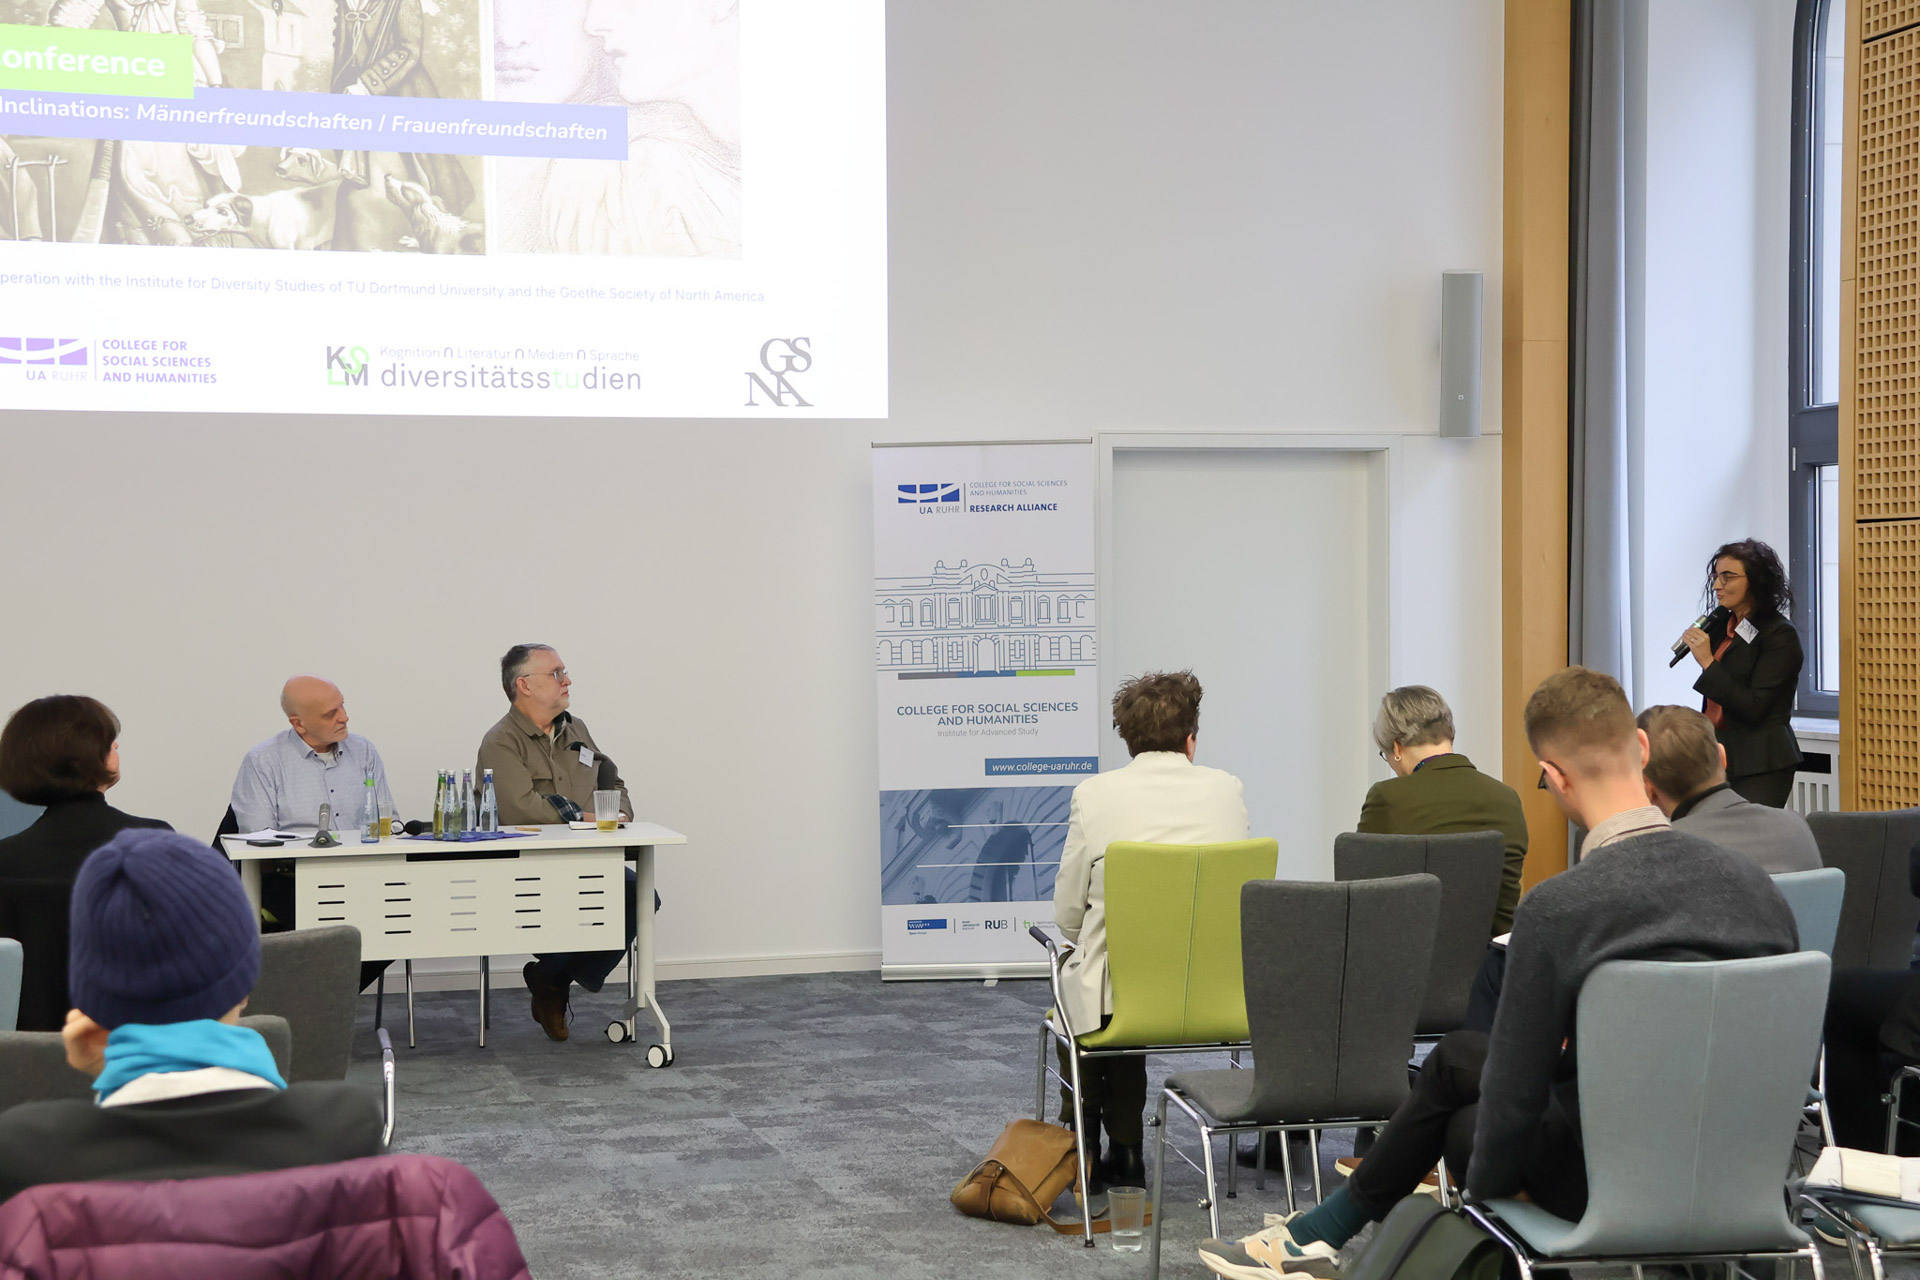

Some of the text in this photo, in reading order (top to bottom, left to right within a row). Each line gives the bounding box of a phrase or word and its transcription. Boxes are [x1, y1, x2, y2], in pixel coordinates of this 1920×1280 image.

[0, 45, 166, 77] onference
[0, 96, 131, 120] Inclinations:
[136, 104, 372, 130] Männerfreundschaften
[392, 116, 608, 140] Frauenfreundschaften
[0, 272, 764, 302] peration with the Institute for Diversity Studies of TU Dortmund University and the Goethe Society of North America
[102, 340, 188, 350] COLLEGE FOR
[380, 346, 640, 362] Kognition Literatur Medien Sprache
[760, 336, 812, 373] GS
[102, 356, 212, 368] SOCIAL SCIENCES
[26, 370, 88, 382] UA RUHR
[102, 372, 218, 384] AND HUMANITIES
[380, 362, 640, 390] diversitätsstudien
[744, 371, 814, 407] NA
[920, 506, 960, 514] UA RUHR
[970, 504, 1058, 512] RESEARCH ALLIANCE
[896, 702, 1079, 716] COLLEGE FOR SOCIAL SCIENCES
[937, 714, 1039, 726] AND HUMANITIES
[937, 728, 1038, 737] Institute for Advanced Study
[992, 761, 1093, 772] www.college-uaruhr.de
[984, 920, 1008, 930] RUB
